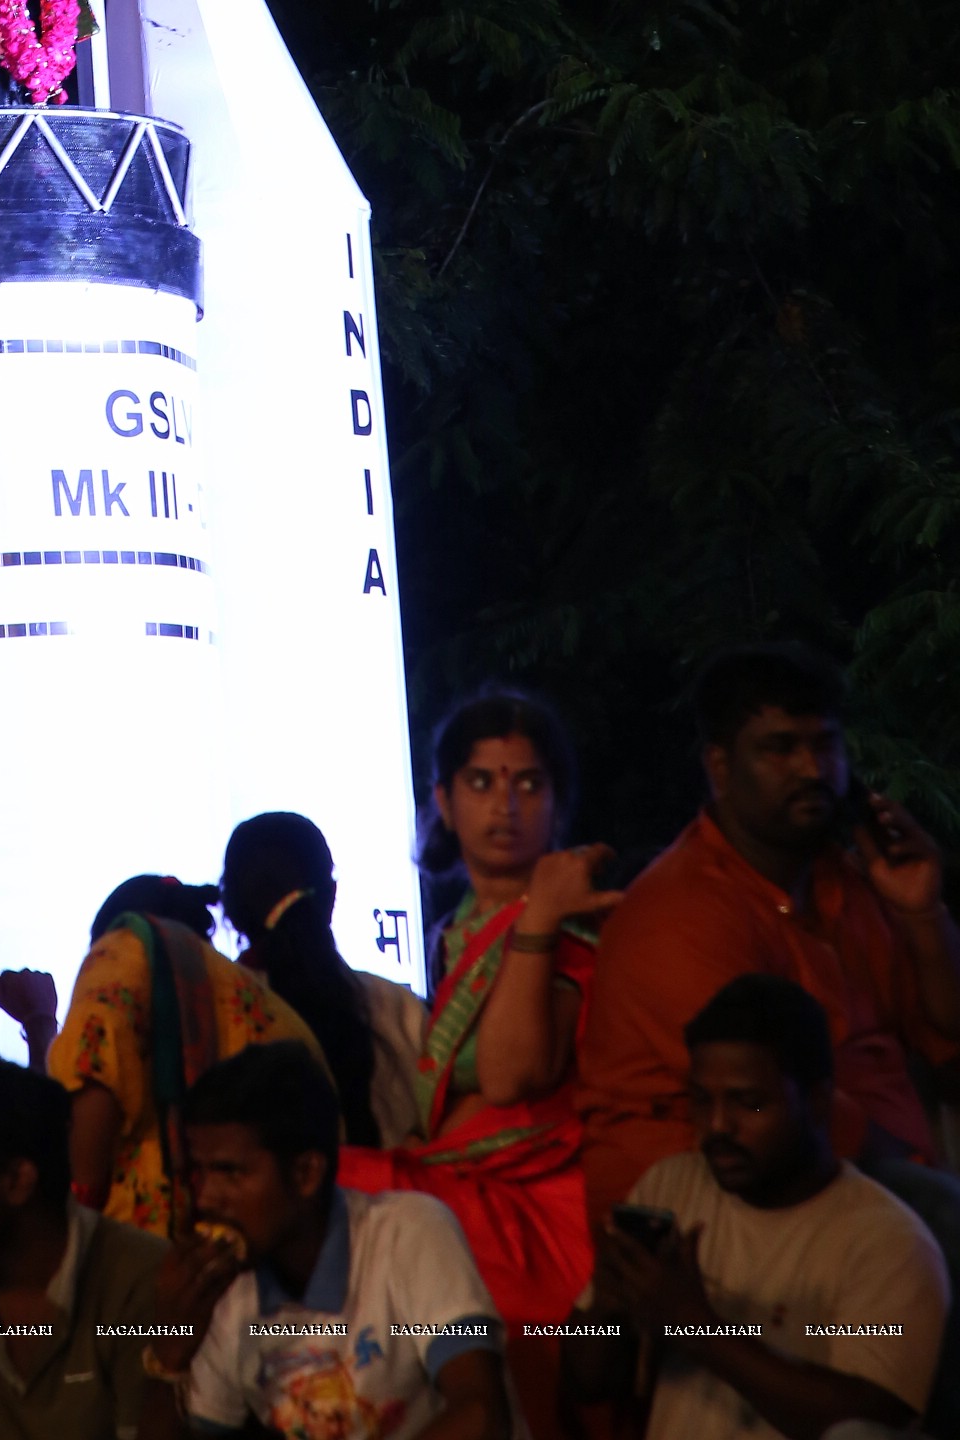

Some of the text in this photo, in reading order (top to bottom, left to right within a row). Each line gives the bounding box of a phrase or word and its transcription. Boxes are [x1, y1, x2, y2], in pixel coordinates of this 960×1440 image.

[51, 469, 206, 529] Mk III-
[343, 232, 386, 596] INDIA
